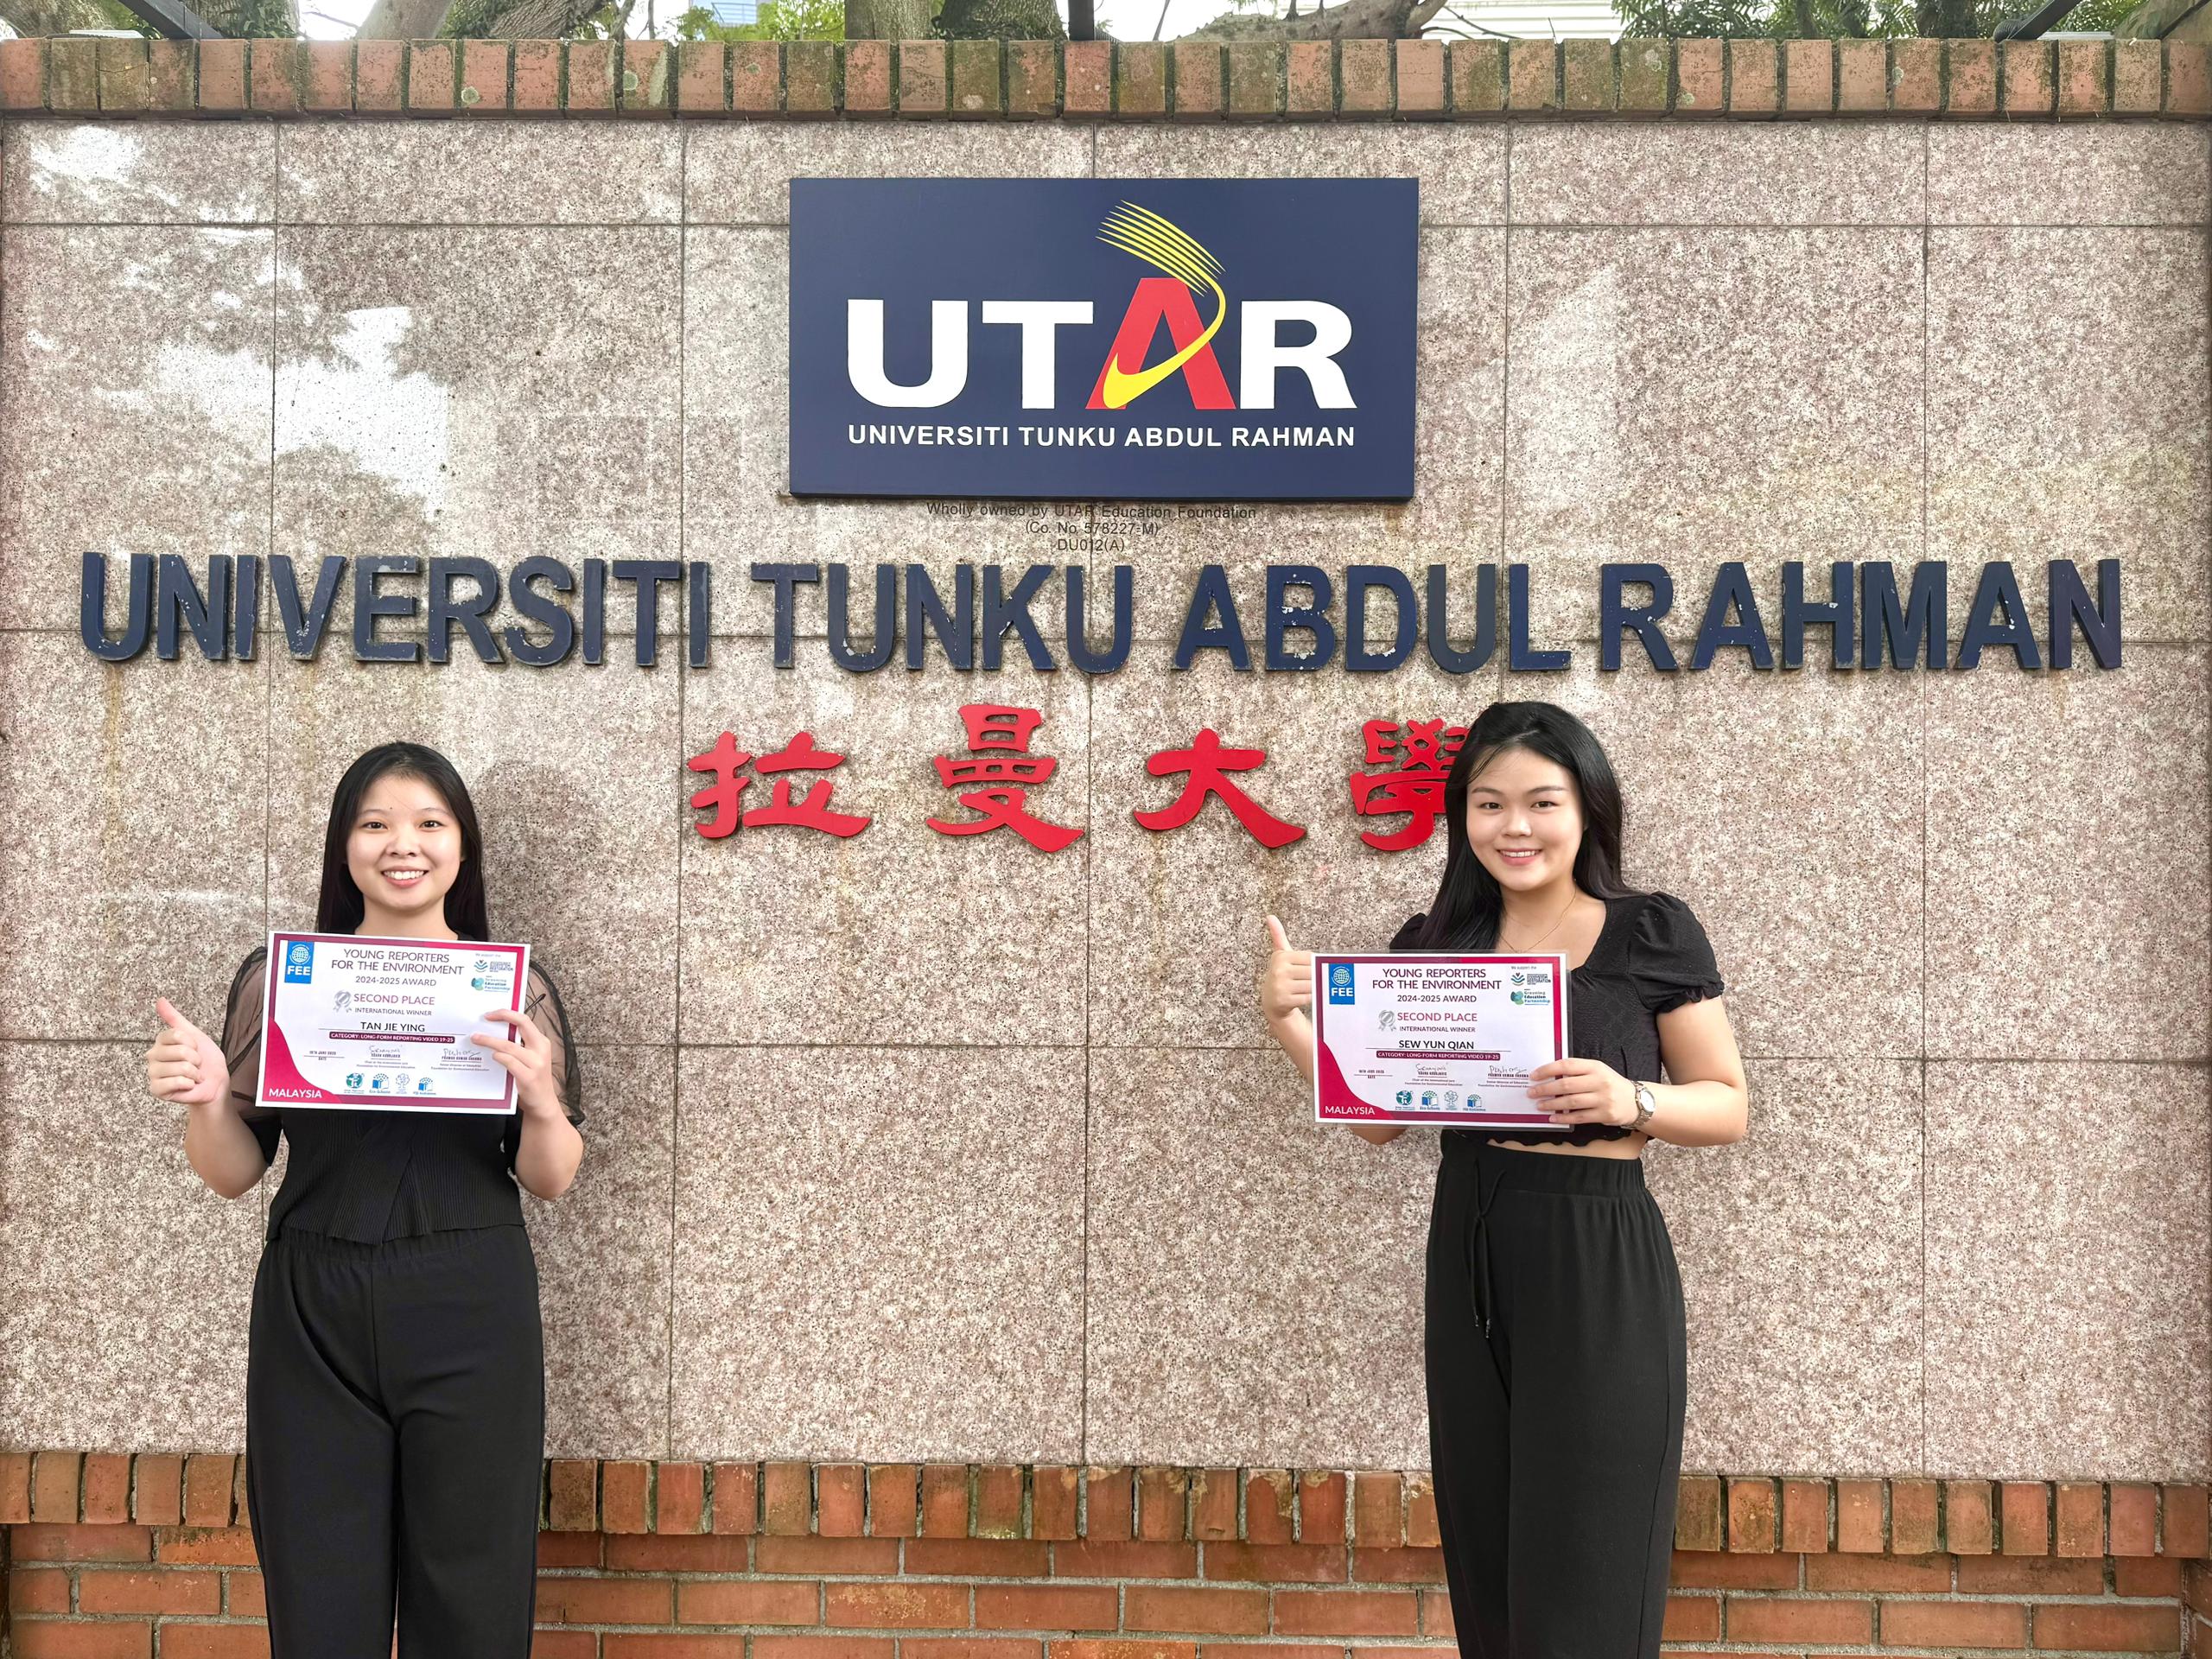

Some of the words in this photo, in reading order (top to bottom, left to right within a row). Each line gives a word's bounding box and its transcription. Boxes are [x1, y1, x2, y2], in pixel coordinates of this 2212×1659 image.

[847, 276, 1357, 410] UTAR
[849, 424, 1008, 447] UNIVERSITI
[1019, 426, 1116, 448] TUNKU
[1124, 426, 1222, 448] ABDUL
[1232, 426, 1354, 448] RAHMAN
[926, 503, 974, 518] Wholly
[980, 505, 1025, 517] owned
[1032, 505, 1049, 519] by
[1054, 505, 1093, 517] UTAR
[1102, 505, 1171, 518] Education
[1177, 506, 1256, 519] Foundation
[1026, 521, 1052, 535] (Co.
[1057, 538, 1125, 553] DU012(A)
[80, 551, 710, 668] UNIVERSITI
[751, 563, 1133, 674] TUNKU
[1171, 563, 1572, 674] ABDUL
[1601, 558, 2124, 671] RAHMAN
[344, 949, 385, 960] YOUNG
[388, 950, 450, 963] REPORTERS
[287, 965, 311, 976] FEE
[331, 960, 353, 969] FOR
[358, 961, 378, 971] THE
[383, 962, 465, 976] ENVIRONMENT
[1382, 969, 1422, 978] YOUNG
[1427, 969, 1486, 978] REPORTERS
[355, 976, 400, 985] 2024-2025
[402, 977, 436, 987] AWARD
[1372, 980, 1394, 989] FOR
[1397, 980, 1419, 989] THE
[1422, 980, 1502, 989] ENVIRONMENT
[1331, 988, 1353, 997] FEE
[353, 993, 399, 1004] SECOND
[401, 995, 435, 1006] PLACE
[1397, 1013, 1441, 1021] SECOND
[1444, 1013, 1478, 1021] PLACE
[360, 1021, 381, 1031] TAN
[384, 1022, 397, 1032] JIE
[400, 1023, 425, 1033] YING
[1399, 1039, 1421, 1048] SEW
[1422, 1040, 1445, 1049] YUN
[1448, 1040, 1474, 1050] QIAN
[269, 1088, 322, 1099] MALAYSIA
[1325, 1105, 1375, 1116] MALAYSIA
